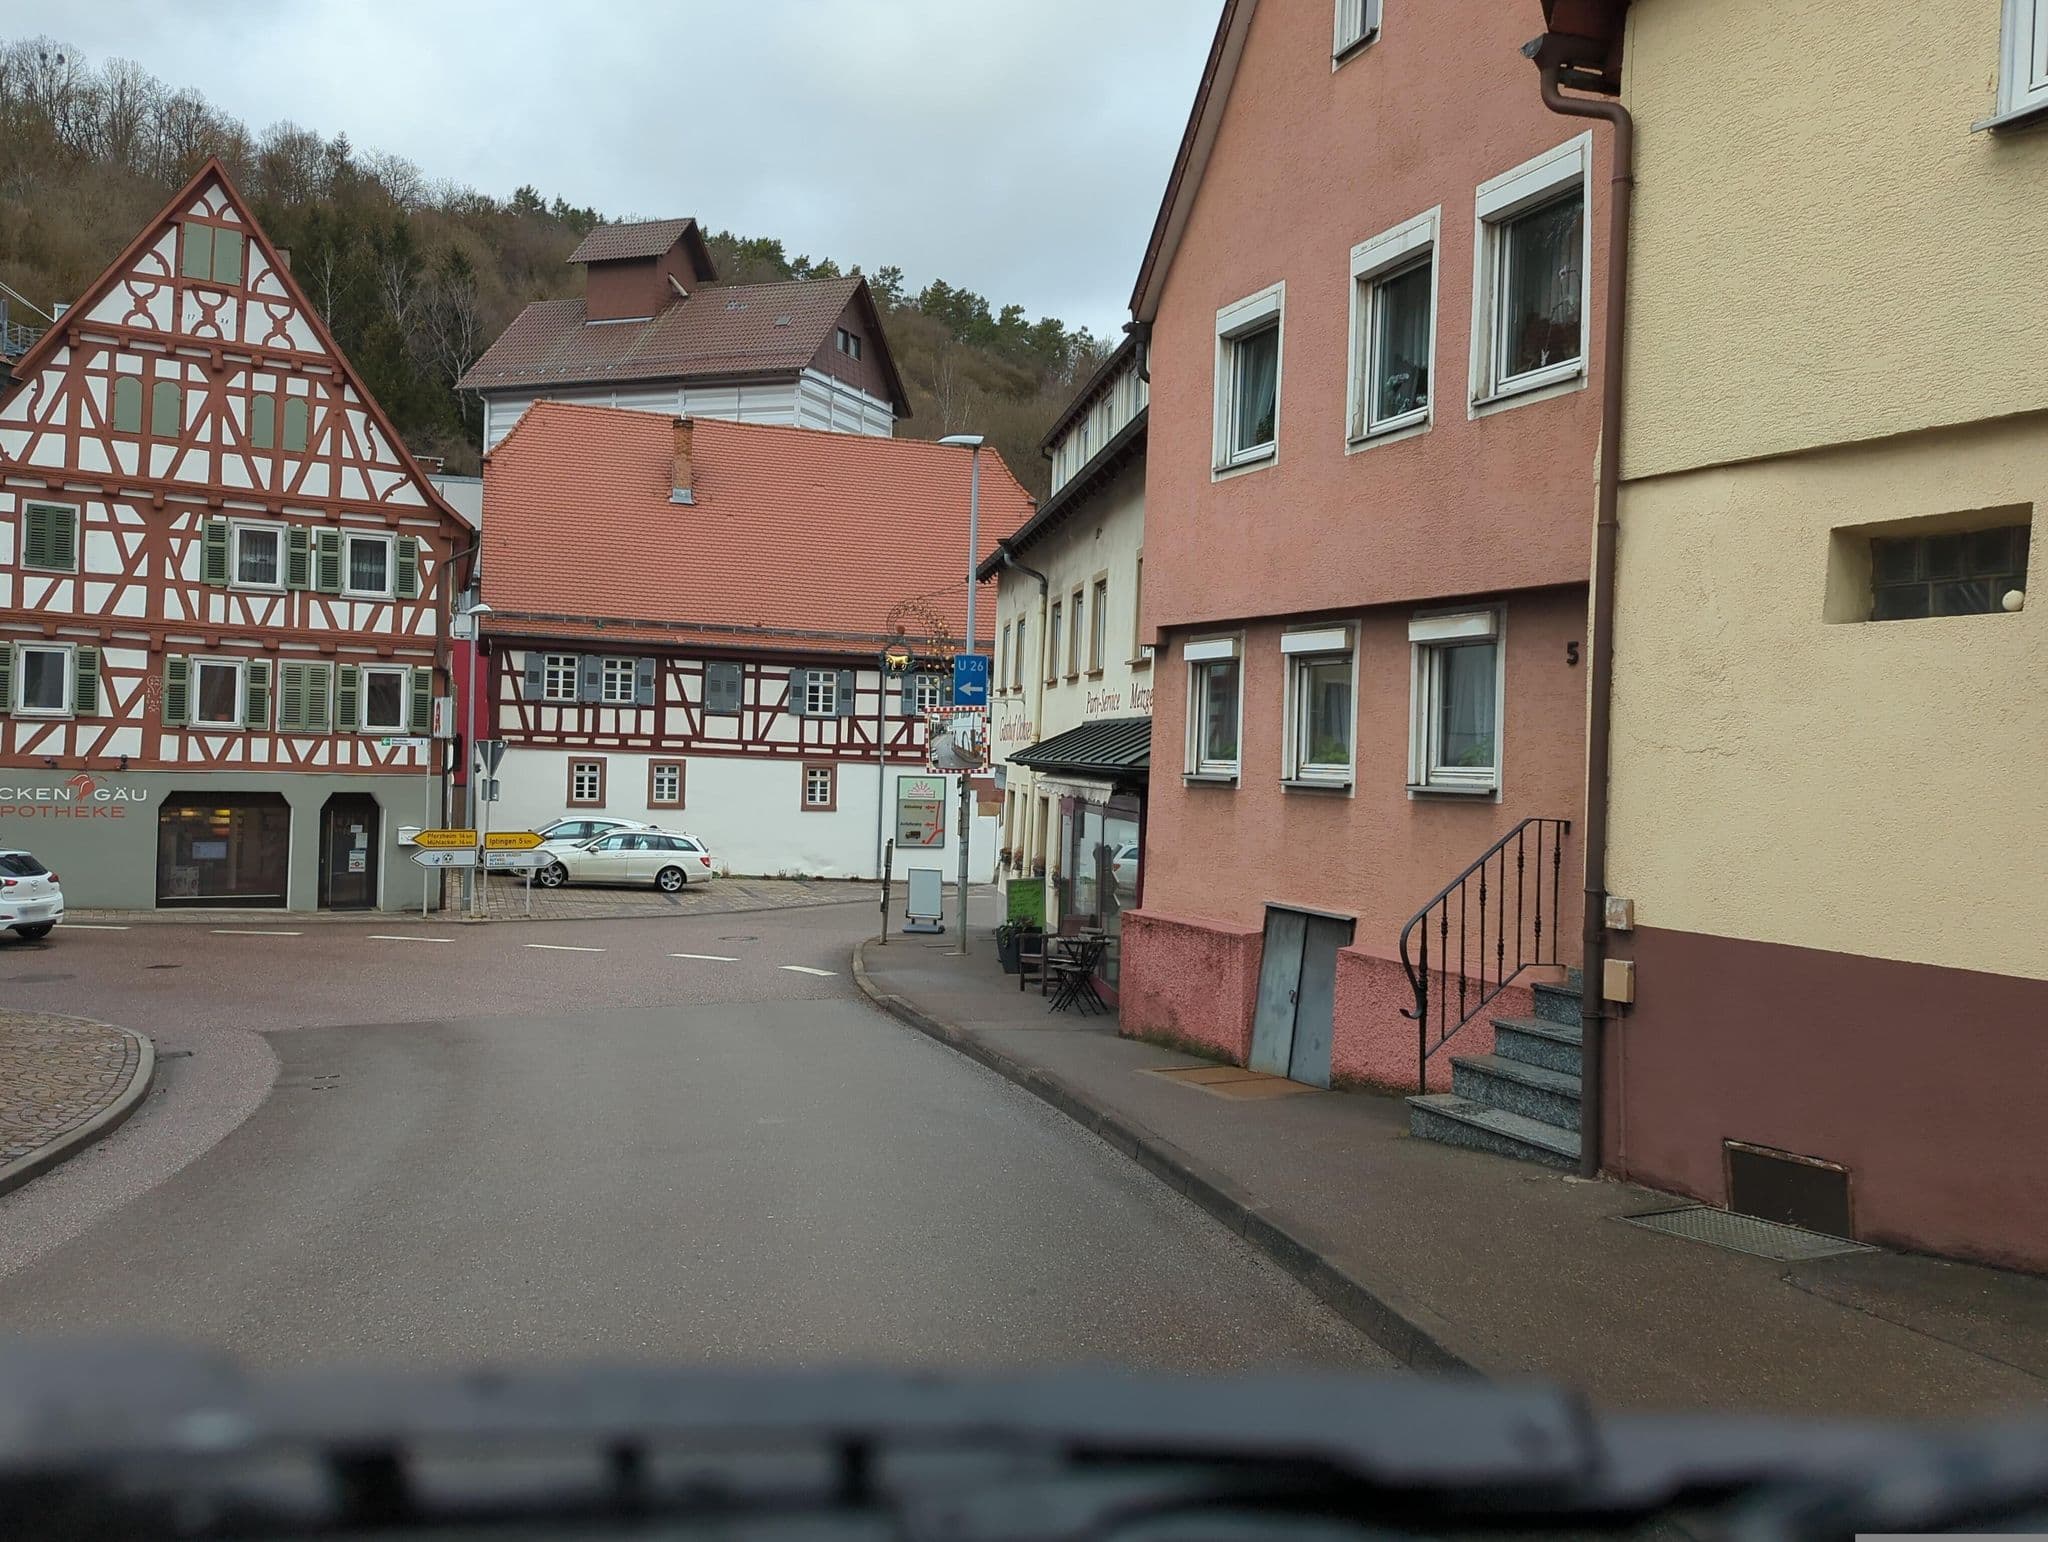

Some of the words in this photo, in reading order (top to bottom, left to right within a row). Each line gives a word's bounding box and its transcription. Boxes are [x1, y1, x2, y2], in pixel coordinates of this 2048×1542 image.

[1566, 641, 1580, 666] 5
[958, 660, 967, 671] U
[970, 660, 984, 672] 26
[1086, 688, 1121, 718] Party-Service
[94, 786, 147, 801] GÄU
[0, 805, 126, 818] POTHEKE
[489, 838, 517, 846] Iptingen
